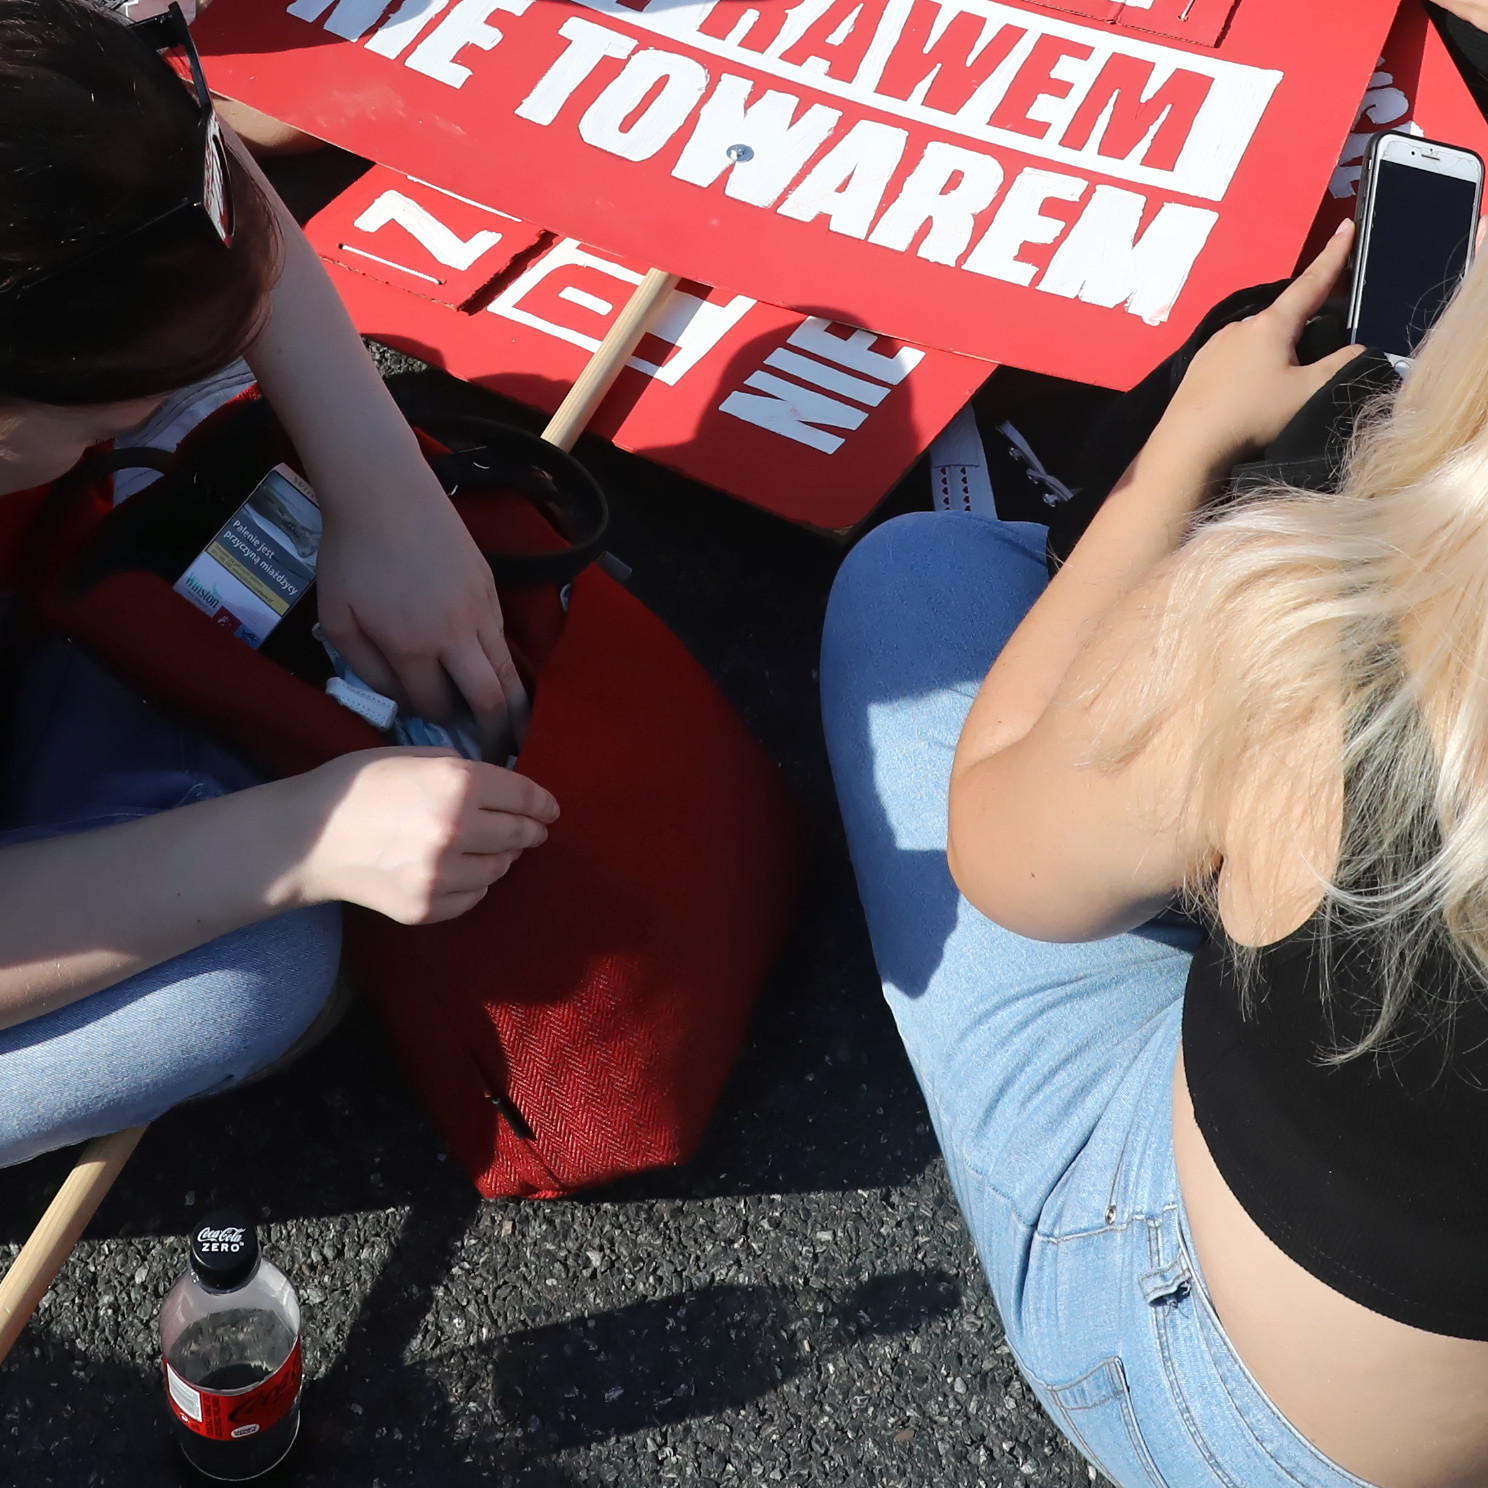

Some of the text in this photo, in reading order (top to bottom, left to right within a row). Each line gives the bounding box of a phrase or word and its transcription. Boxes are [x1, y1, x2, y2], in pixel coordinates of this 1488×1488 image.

[515, 16, 1220, 326] TOWAREM
[720, 316, 925, 455] NIE
[223, 530, 261, 564] przyczyną
[260, 560, 299, 596] miażdżycy
[232, 519, 275, 560] Palenie jest
